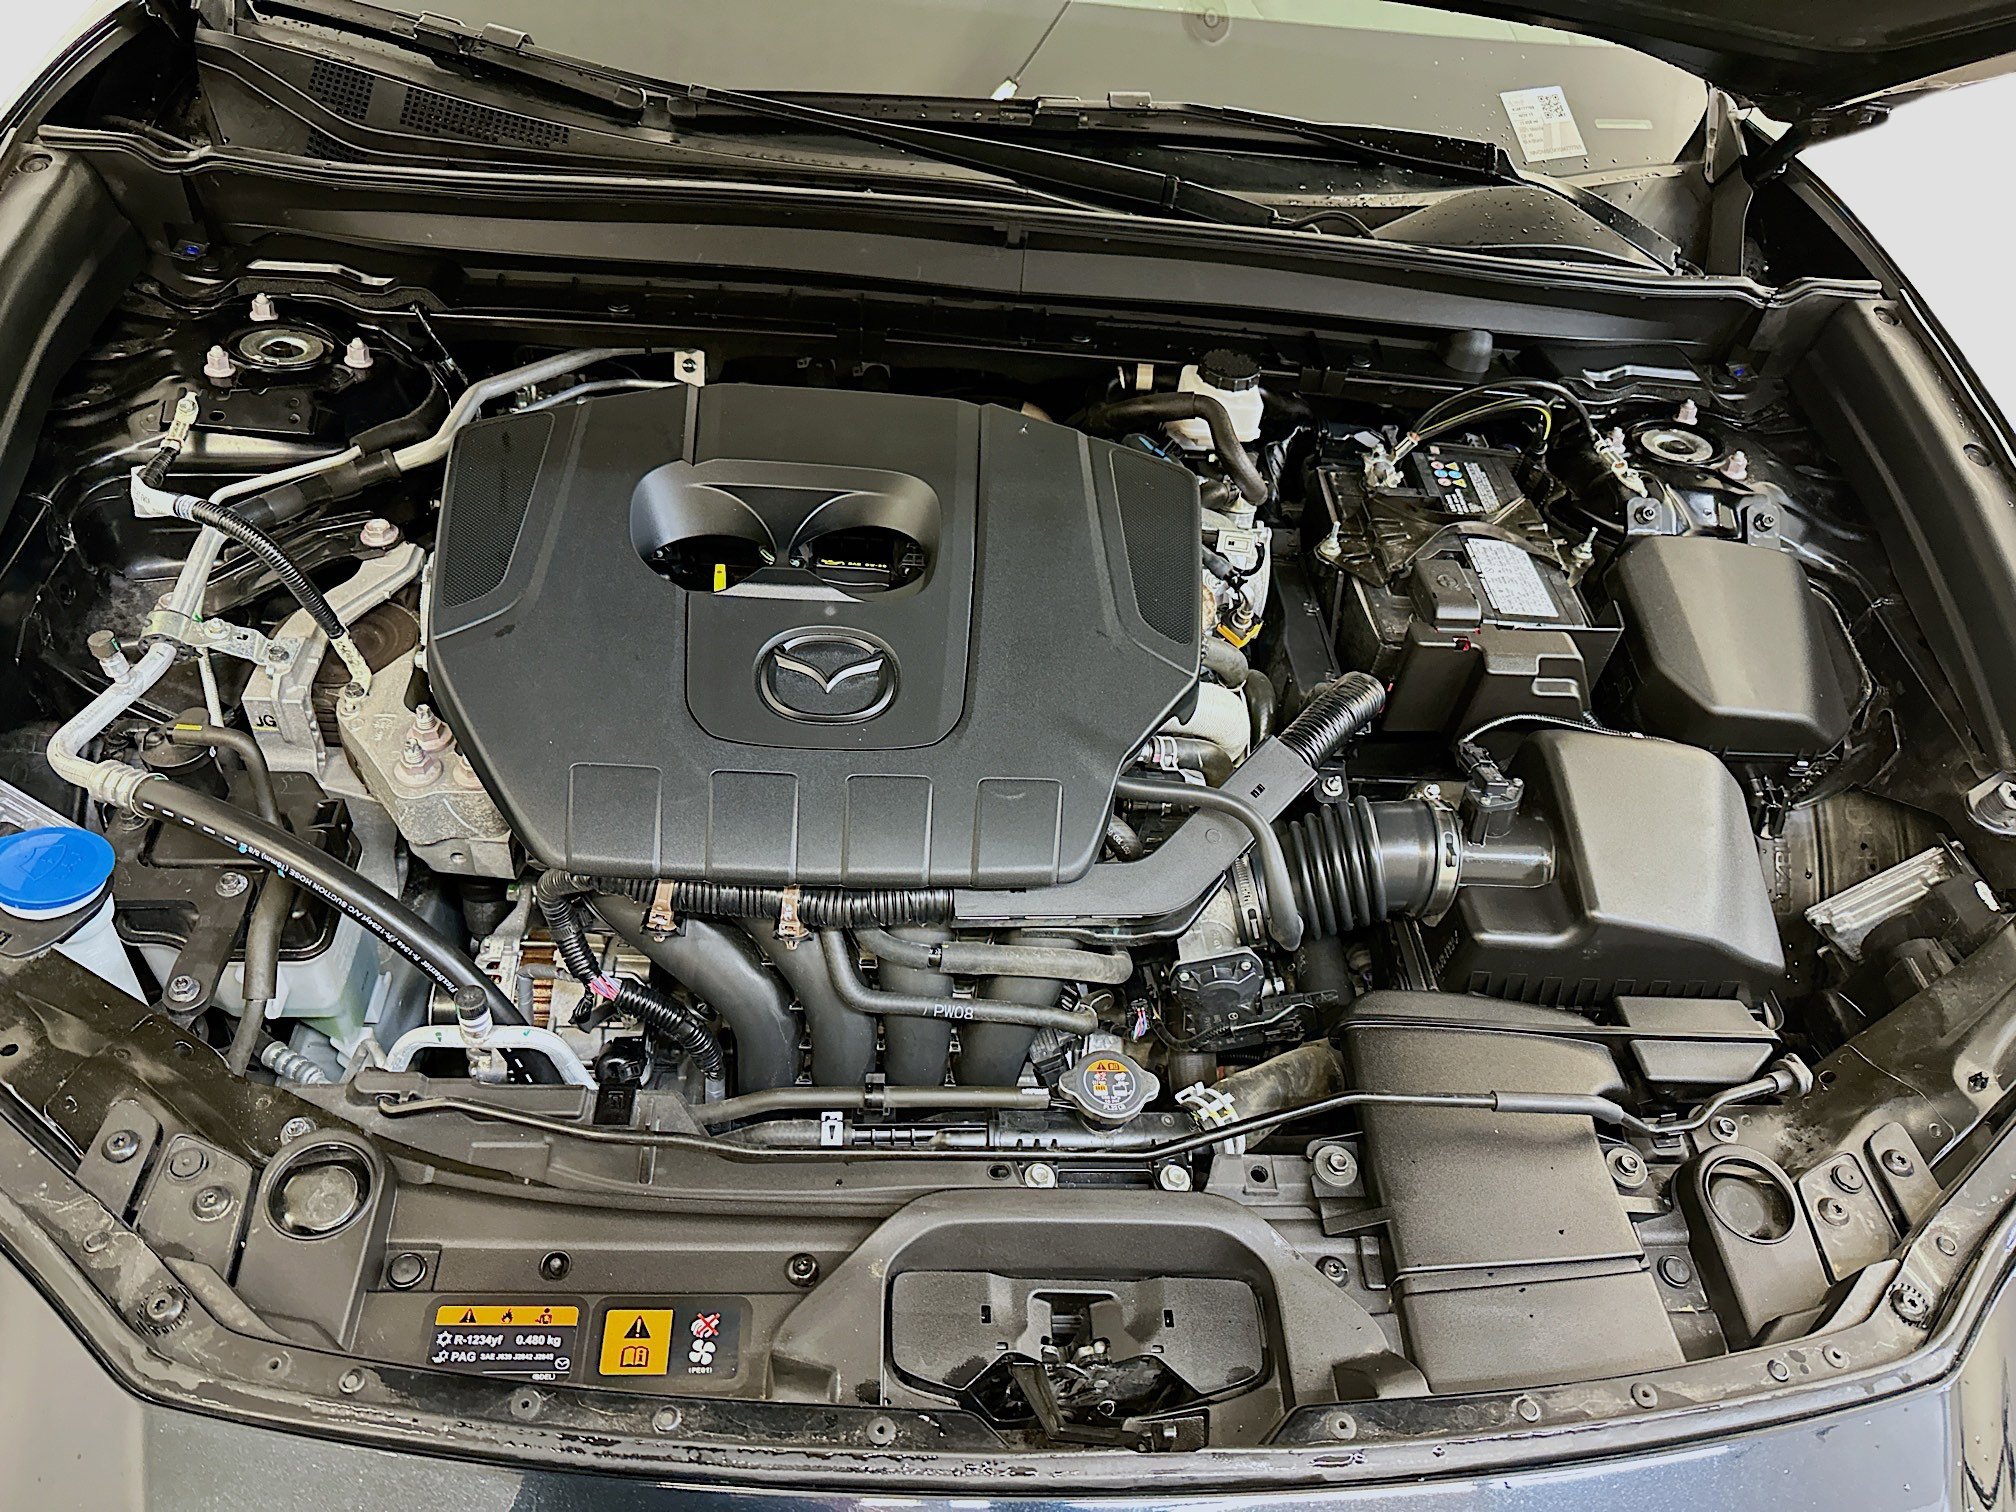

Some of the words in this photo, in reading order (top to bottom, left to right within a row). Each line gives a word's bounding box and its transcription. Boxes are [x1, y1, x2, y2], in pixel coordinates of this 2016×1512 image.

[256, 715, 277, 727] JG
[260, 852, 289, 873] (16mm)
[288, 868, 313, 887] HOSE
[312, 884, 348, 909] SUCTION
[347, 902, 363, 918] A/C
[361, 914, 393, 941] R-1234yf
[396, 940, 421, 962] R-134a
[421, 960, 459, 994] FlexBarrier
[934, 1004, 973, 1019] PW08
[454, 1335, 504, 1347] R-1234yf
[515, 1335, 545, 1345] 0.480
[547, 1335, 561, 1347] kg
[450, 1351, 476, 1362] PAG
